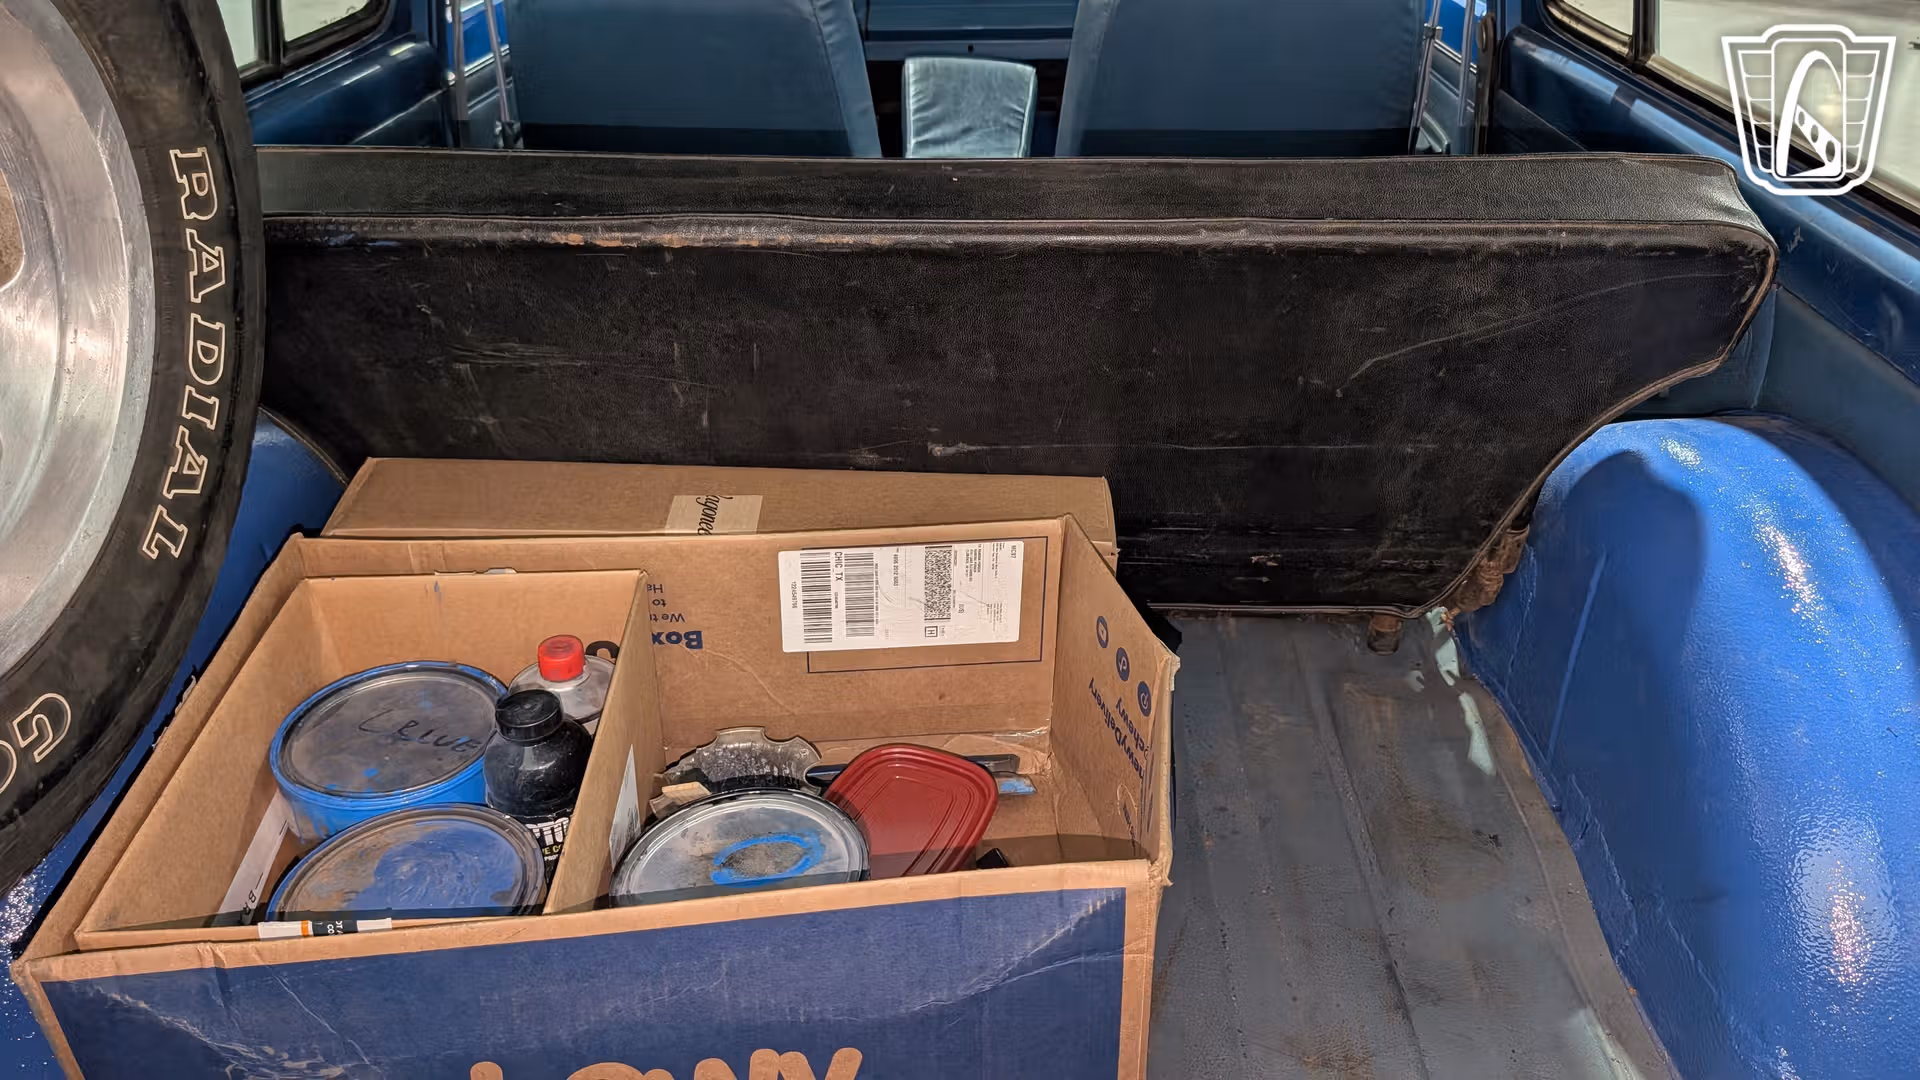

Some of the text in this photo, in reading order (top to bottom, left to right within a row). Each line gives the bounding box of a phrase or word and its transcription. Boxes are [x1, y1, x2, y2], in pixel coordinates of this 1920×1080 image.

[141, 147, 226, 560] RADIAL
[652, 599, 667, 608] to
[661, 613, 685, 623] We
